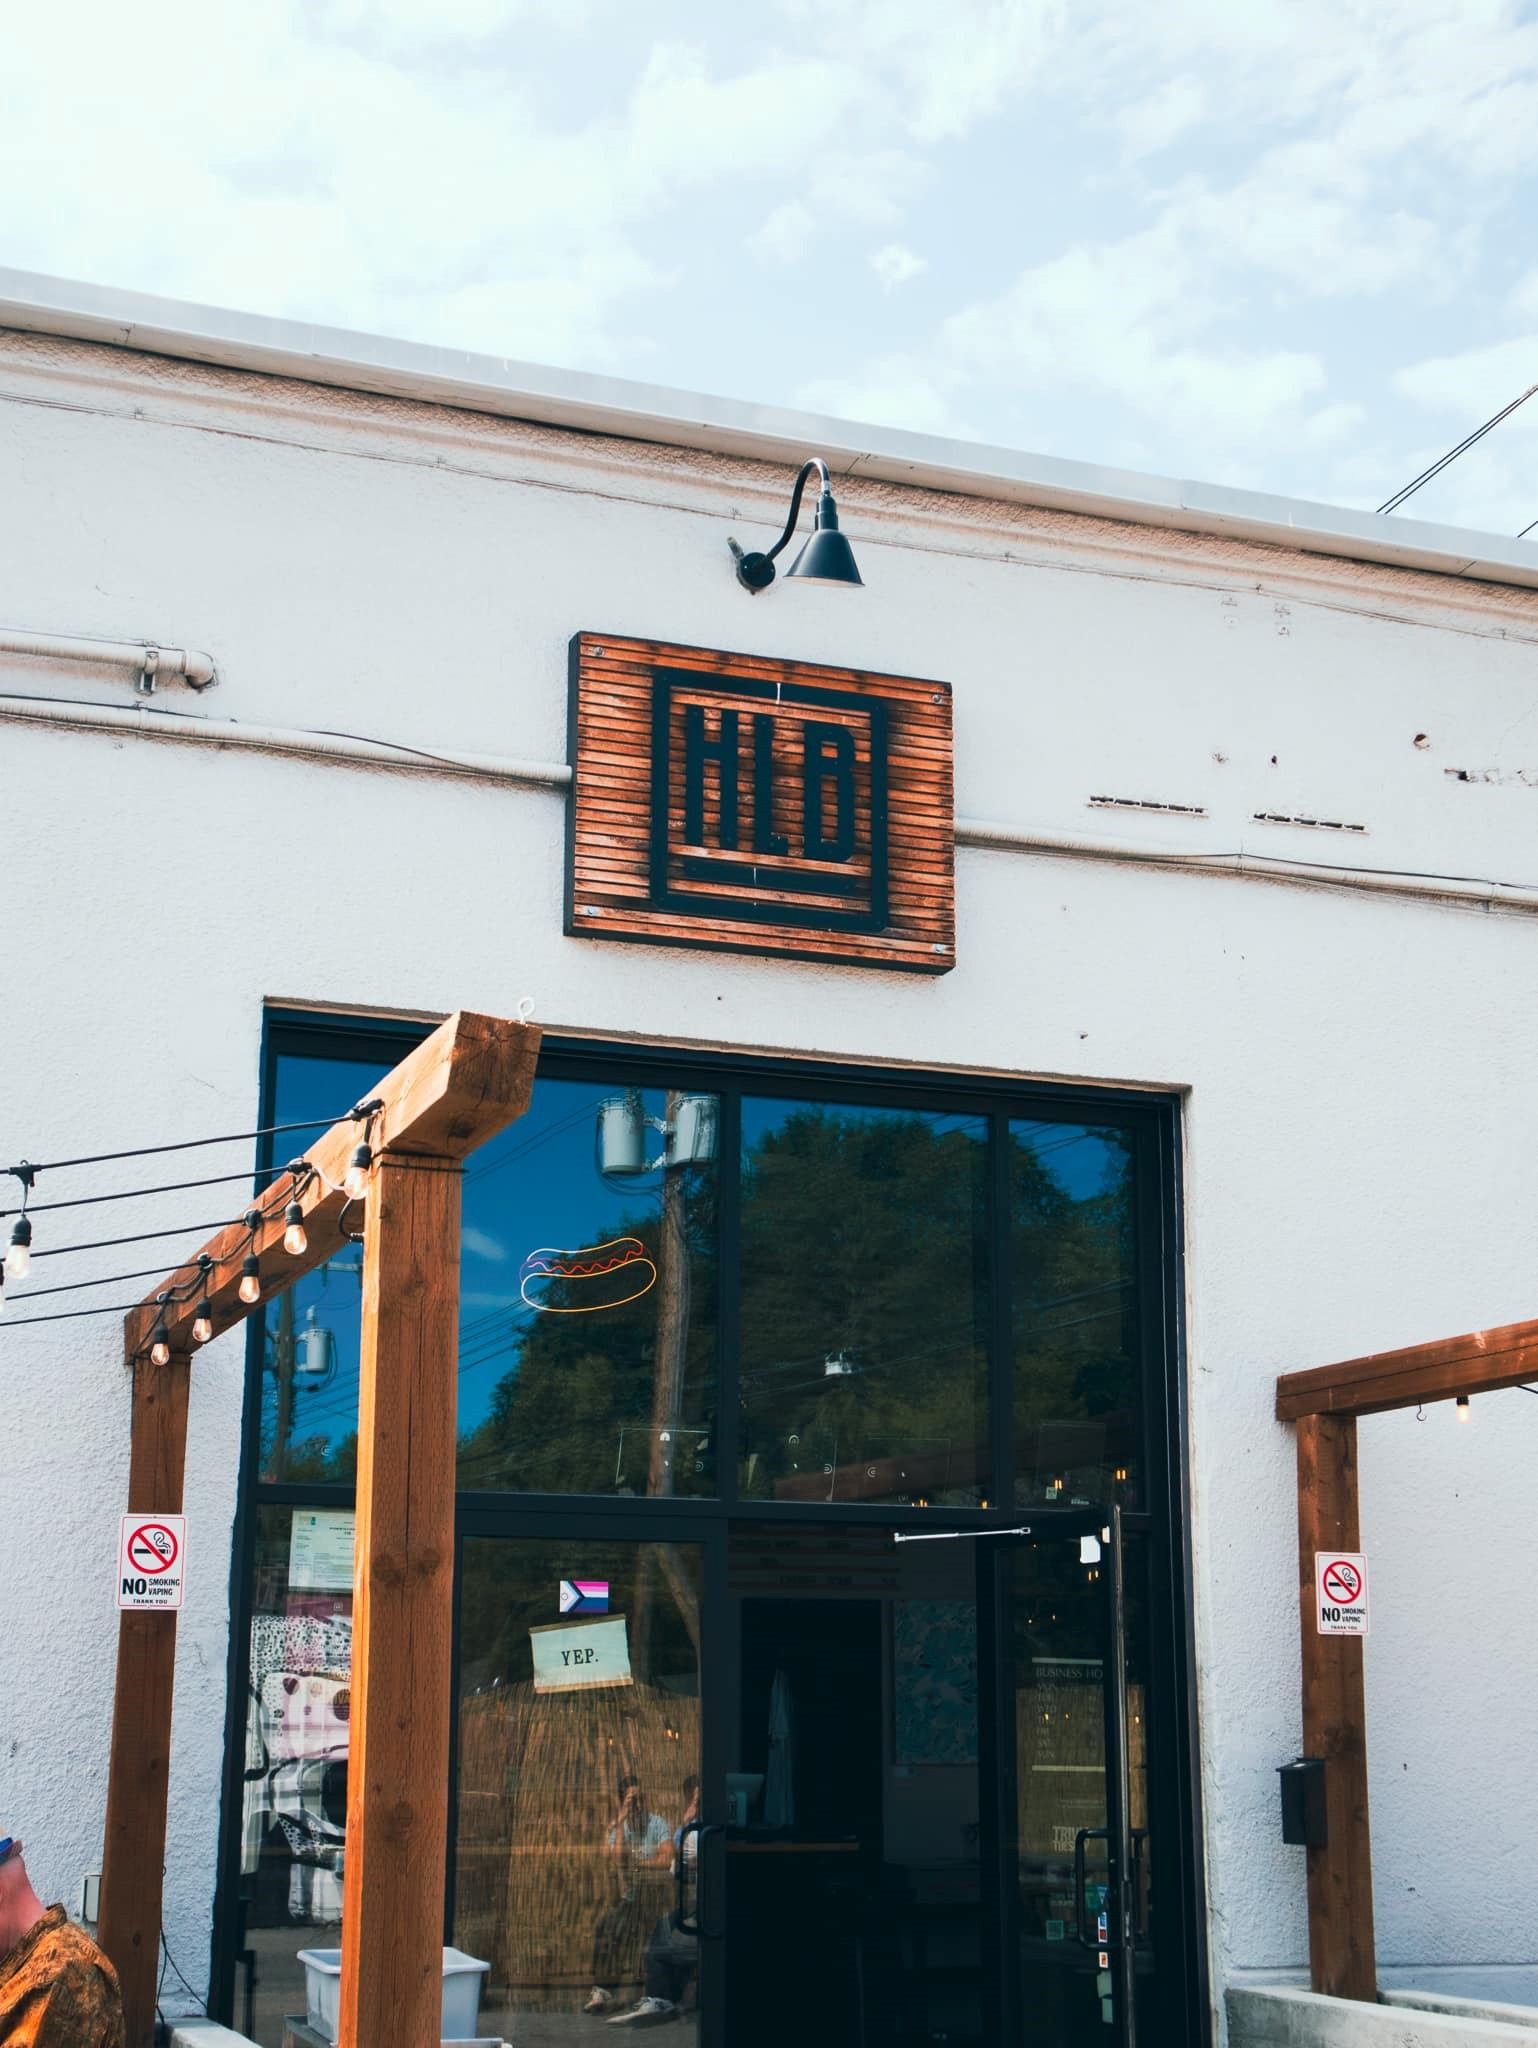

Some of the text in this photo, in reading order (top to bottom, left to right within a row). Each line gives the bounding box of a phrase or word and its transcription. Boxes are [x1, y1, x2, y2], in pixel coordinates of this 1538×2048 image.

[686, 705, 856, 862] HLB
[122, 1578, 180, 1595] NO SMOKING
[148, 1587, 173, 1596] VAPING
[1322, 1608, 1341, 1622] NO
[561, 1648, 600, 1666] YEP.
[1035, 1667, 1082, 1678] BUSINESS
[1052, 1826, 1088, 1841] TRIV
[1053, 1841, 1090, 1852] TUESY
